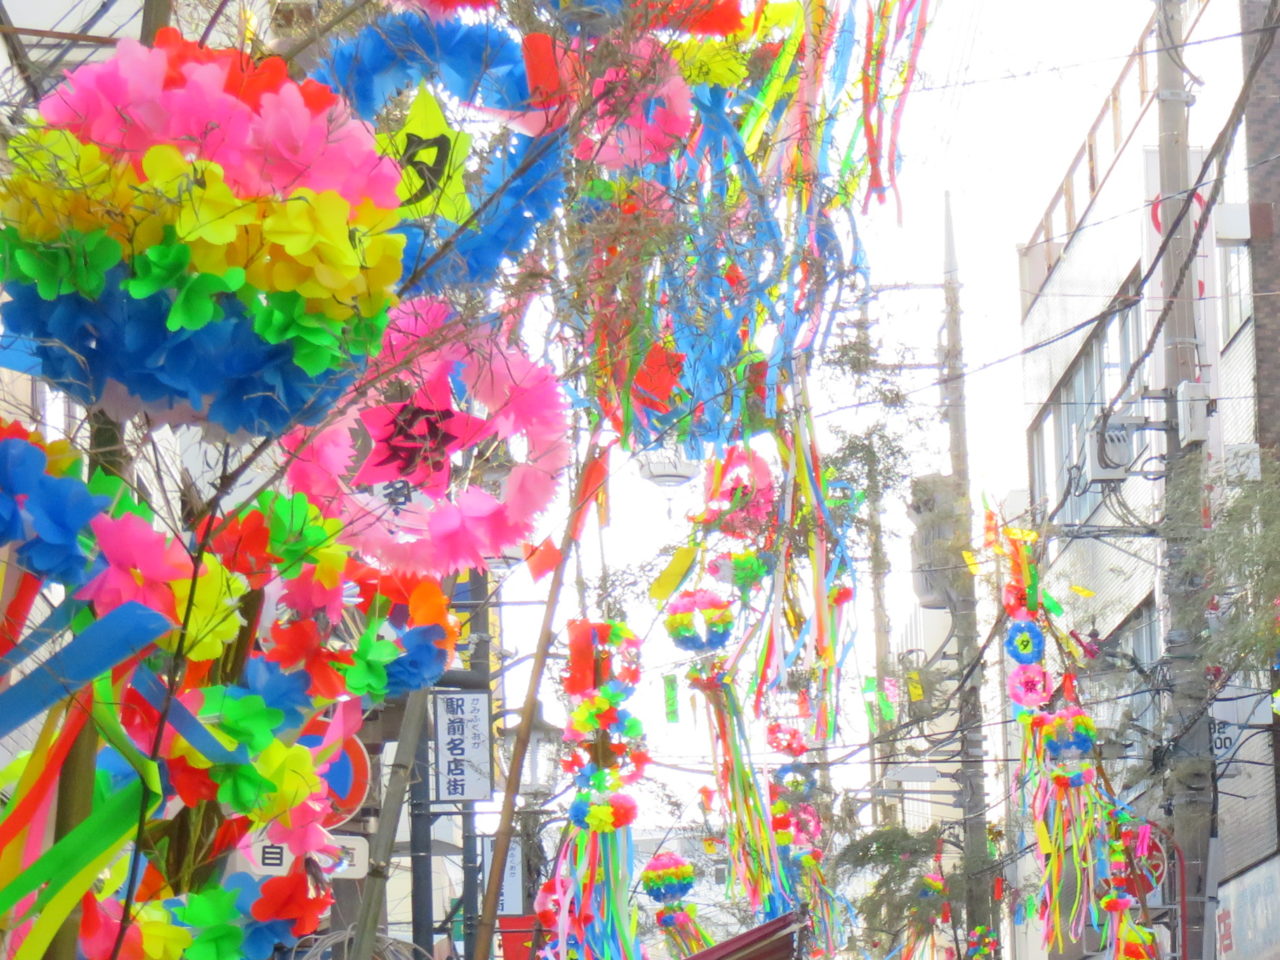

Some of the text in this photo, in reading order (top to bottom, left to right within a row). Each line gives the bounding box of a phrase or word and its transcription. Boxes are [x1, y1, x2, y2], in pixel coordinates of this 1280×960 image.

[445, 697, 465, 797] 駅前名店街
